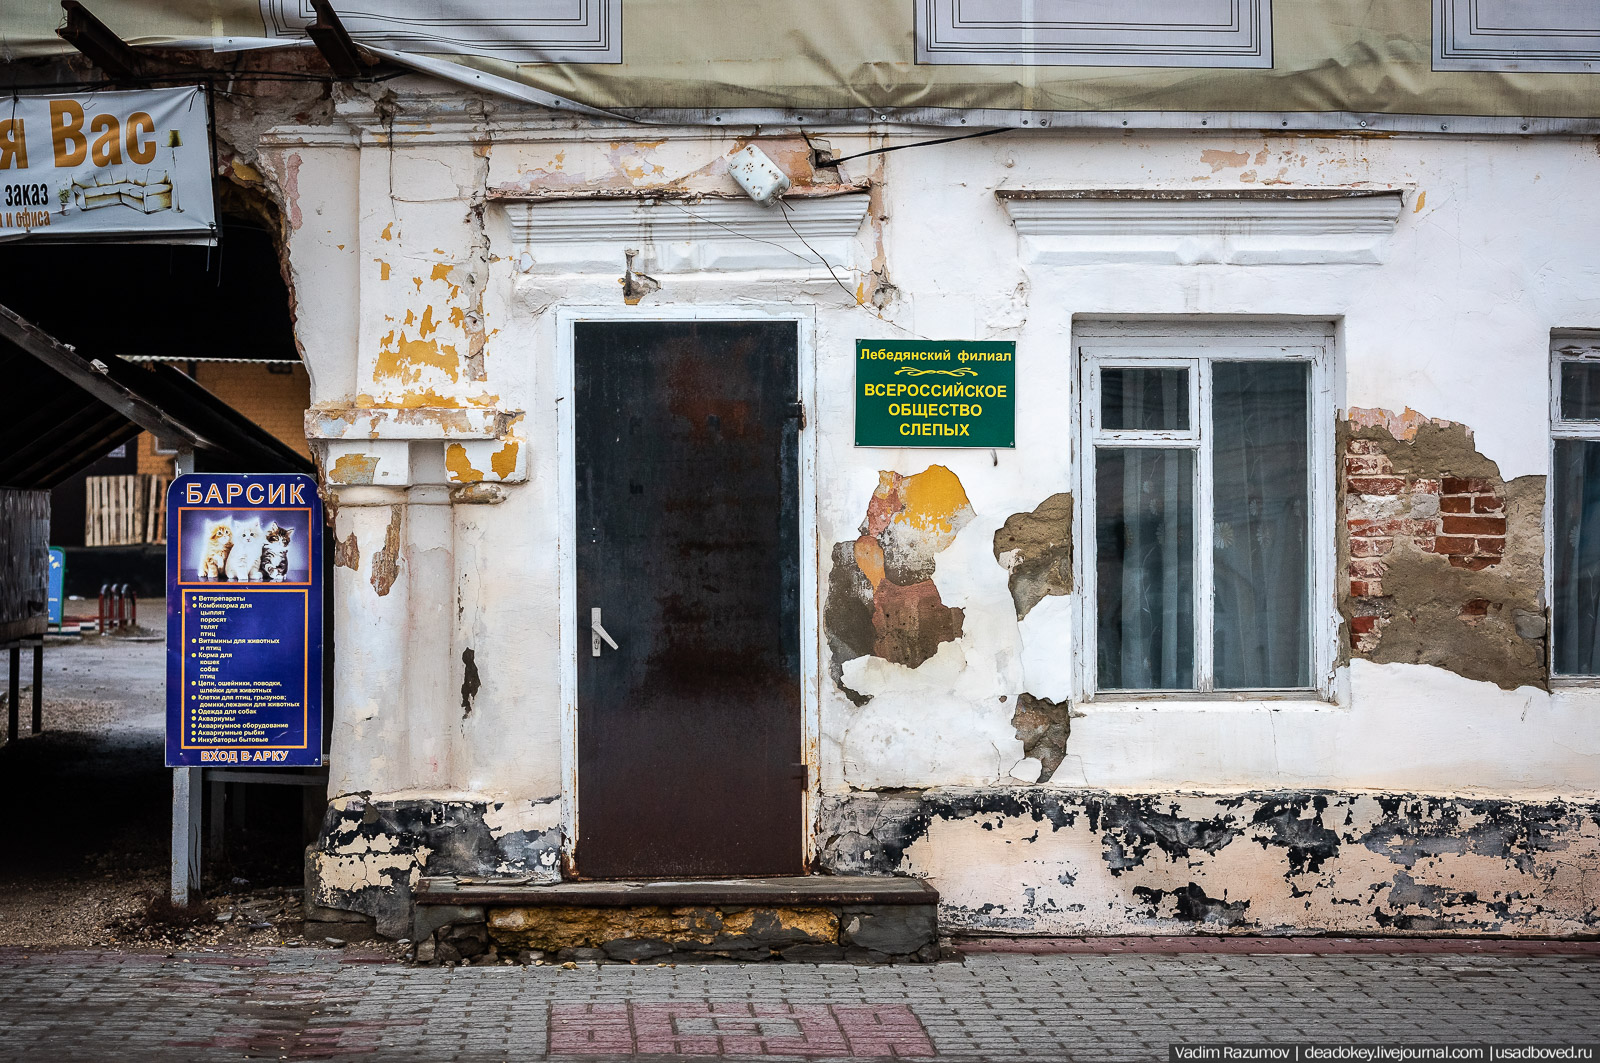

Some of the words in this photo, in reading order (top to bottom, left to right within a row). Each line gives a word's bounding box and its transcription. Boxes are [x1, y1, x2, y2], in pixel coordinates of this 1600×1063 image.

[0, 118, 28, 169] я
[49, 99, 156, 168] Вас
[5, 183, 48, 206] заказ
[6, 213, 13, 226] и
[16, 207, 51, 230] офиса
[861, 349, 950, 362] Лебедянский
[958, 350, 1012, 363] филиал
[864, 382, 1007, 397] ВСЕРОССИЙСКОЕ
[888, 403, 982, 418] ОБЩЕСТВО
[899, 423, 970, 436] СЛЕПЫХ
[186, 483, 305, 504] БАРСИК
[201, 751, 238, 763] ВХОД
[241, 751, 250, 761] В
[253, 751, 289, 762] АРКУ
